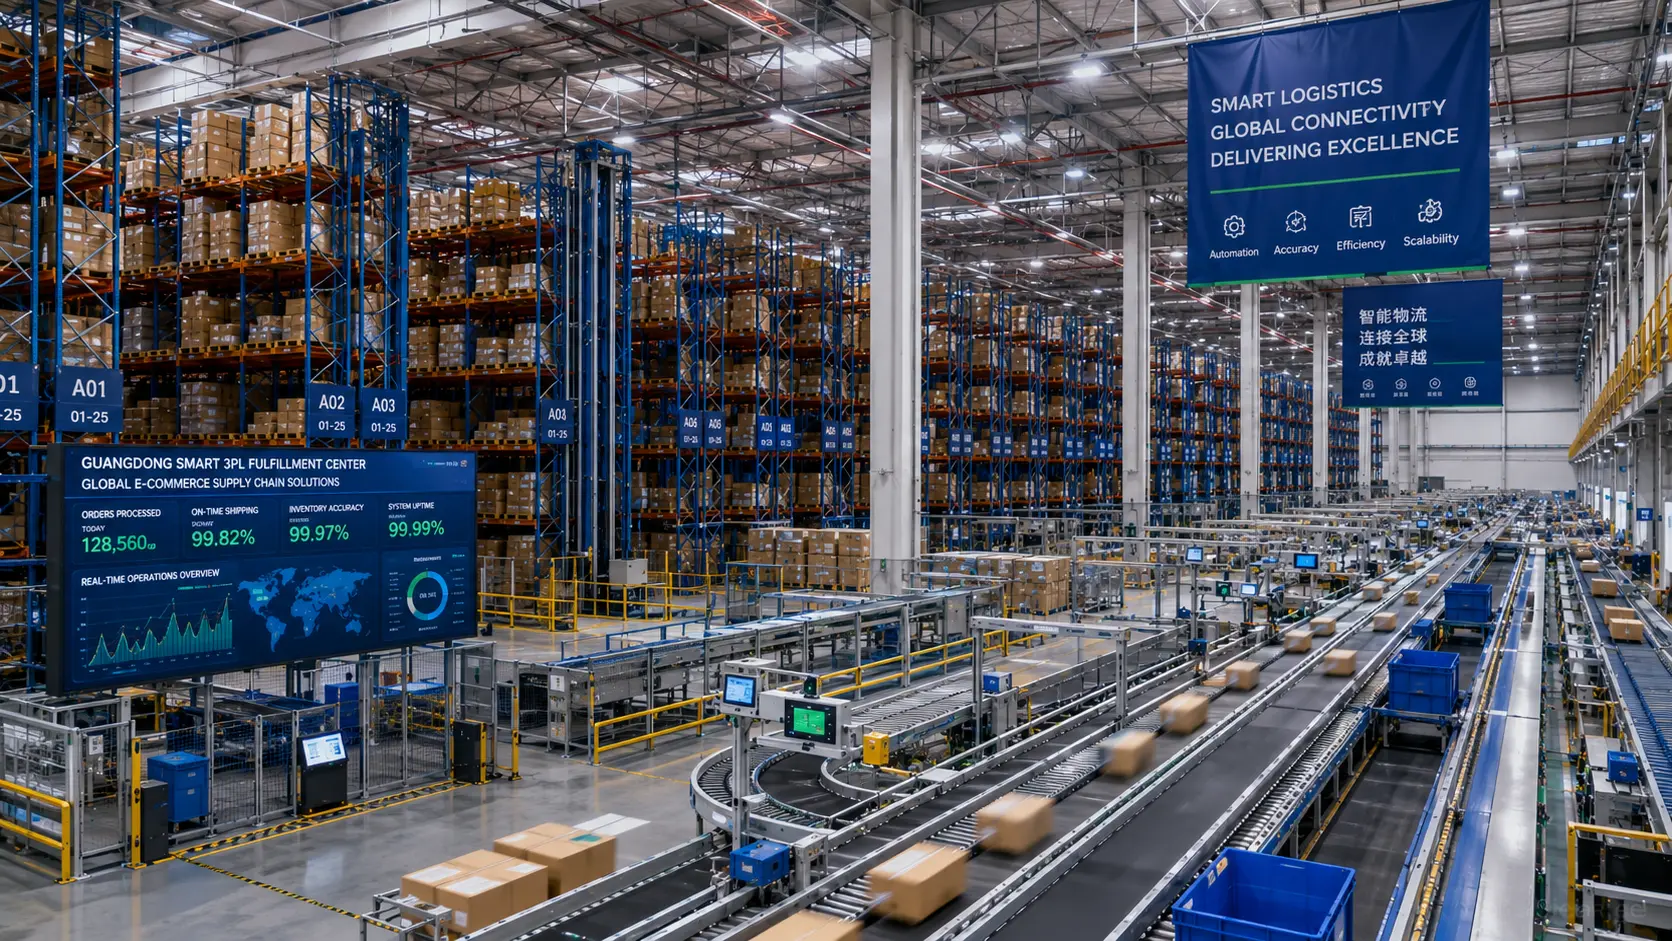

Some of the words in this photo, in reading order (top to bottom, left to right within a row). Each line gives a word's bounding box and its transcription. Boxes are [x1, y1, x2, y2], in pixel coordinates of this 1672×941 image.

[1211, 91, 1275, 113] SMART
[1281, 78, 1382, 105] LOGISTICS
[1211, 118, 1285, 140] GLOBAL
[1291, 99, 1446, 131] CONNECTIVITY
[1211, 142, 1321, 167] DELIVERING
[1328, 128, 1459, 155] EXCELLENCE
[1337, 240, 1385, 250] Efficiency
[1404, 233, 1459, 246] Scalability
[1210, 248, 1258, 258] Automation
[1274, 245, 1319, 254] Accuracy
[1359, 307, 1427, 324] 智能物流
[1360, 328, 1427, 345] 连接全球
[1359, 350, 1427, 366] 成就卓越
[72, 379, 105, 397] A01
[318, 394, 345, 410] A02
[371, 397, 396, 413] A03
[71, 411, 108, 423] 01-25
[318, 420, 346, 431] 01-25
[371, 422, 397, 433] 01-25
[82, 457, 172, 469] GUANGDONG
[177, 458, 220, 469] SMART
[224, 458, 245, 469] 3PL
[249, 458, 322, 469] FULFILLMENT
[326, 459, 366, 469] CENTER
[82, 479, 131, 489] GLOBAL
[135, 478, 210, 489] E-COMMERCE
[213, 478, 251, 488] SUPPLY
[254, 478, 284, 487] CHAIN
[287, 477, 339, 487] SOLUTIONS
[82, 510, 114, 519] ORDERS
[116, 509, 161, 517] PROCESSED
[192, 507, 223, 516] ON-TIME
[225, 507, 258, 515] SHIPPING
[290, 525, 349, 542] 99.97%
[389, 520, 444, 537] 99.99%
[192, 529, 255, 547] 99.82%
[82, 575, 125, 586] REAL-TIME
[127, 572, 177, 582] OPERATIONS
[180, 569, 219, 579] OVERVIEW
